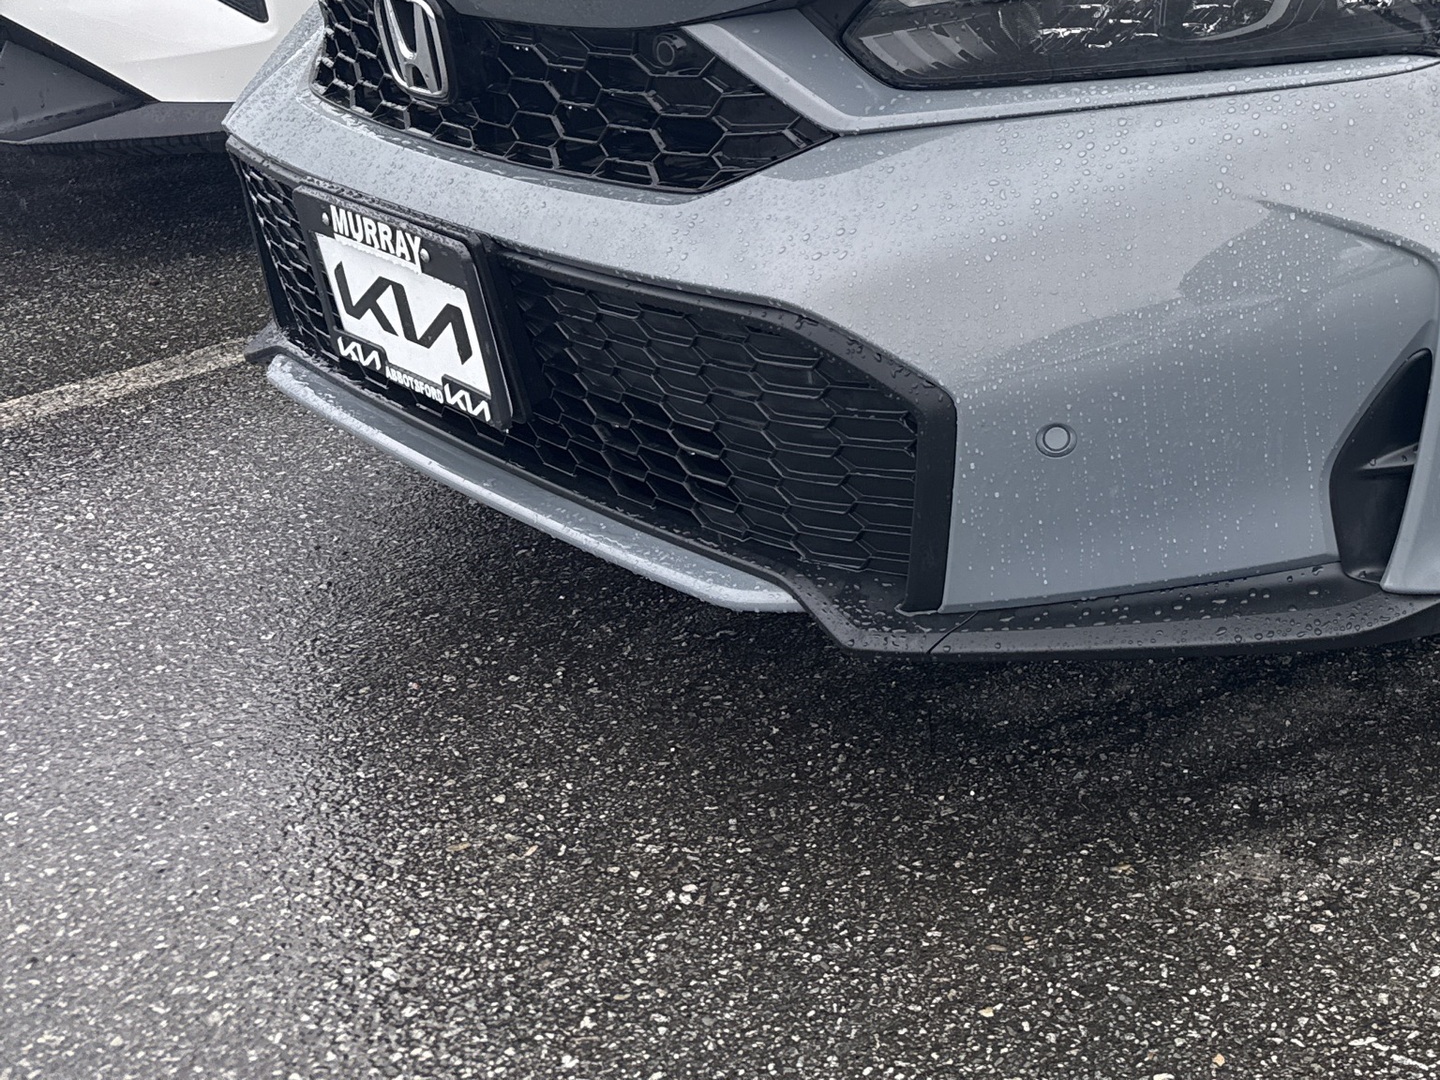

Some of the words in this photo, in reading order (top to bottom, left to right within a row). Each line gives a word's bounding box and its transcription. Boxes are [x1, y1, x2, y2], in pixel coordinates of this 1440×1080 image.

[330, 204, 421, 275] MURRAY
[334, 261, 473, 365] KIA
[337, 336, 382, 370] KIA
[385, 366, 444, 404] ABBOTSFORD
[444, 383, 491, 422] KIA
